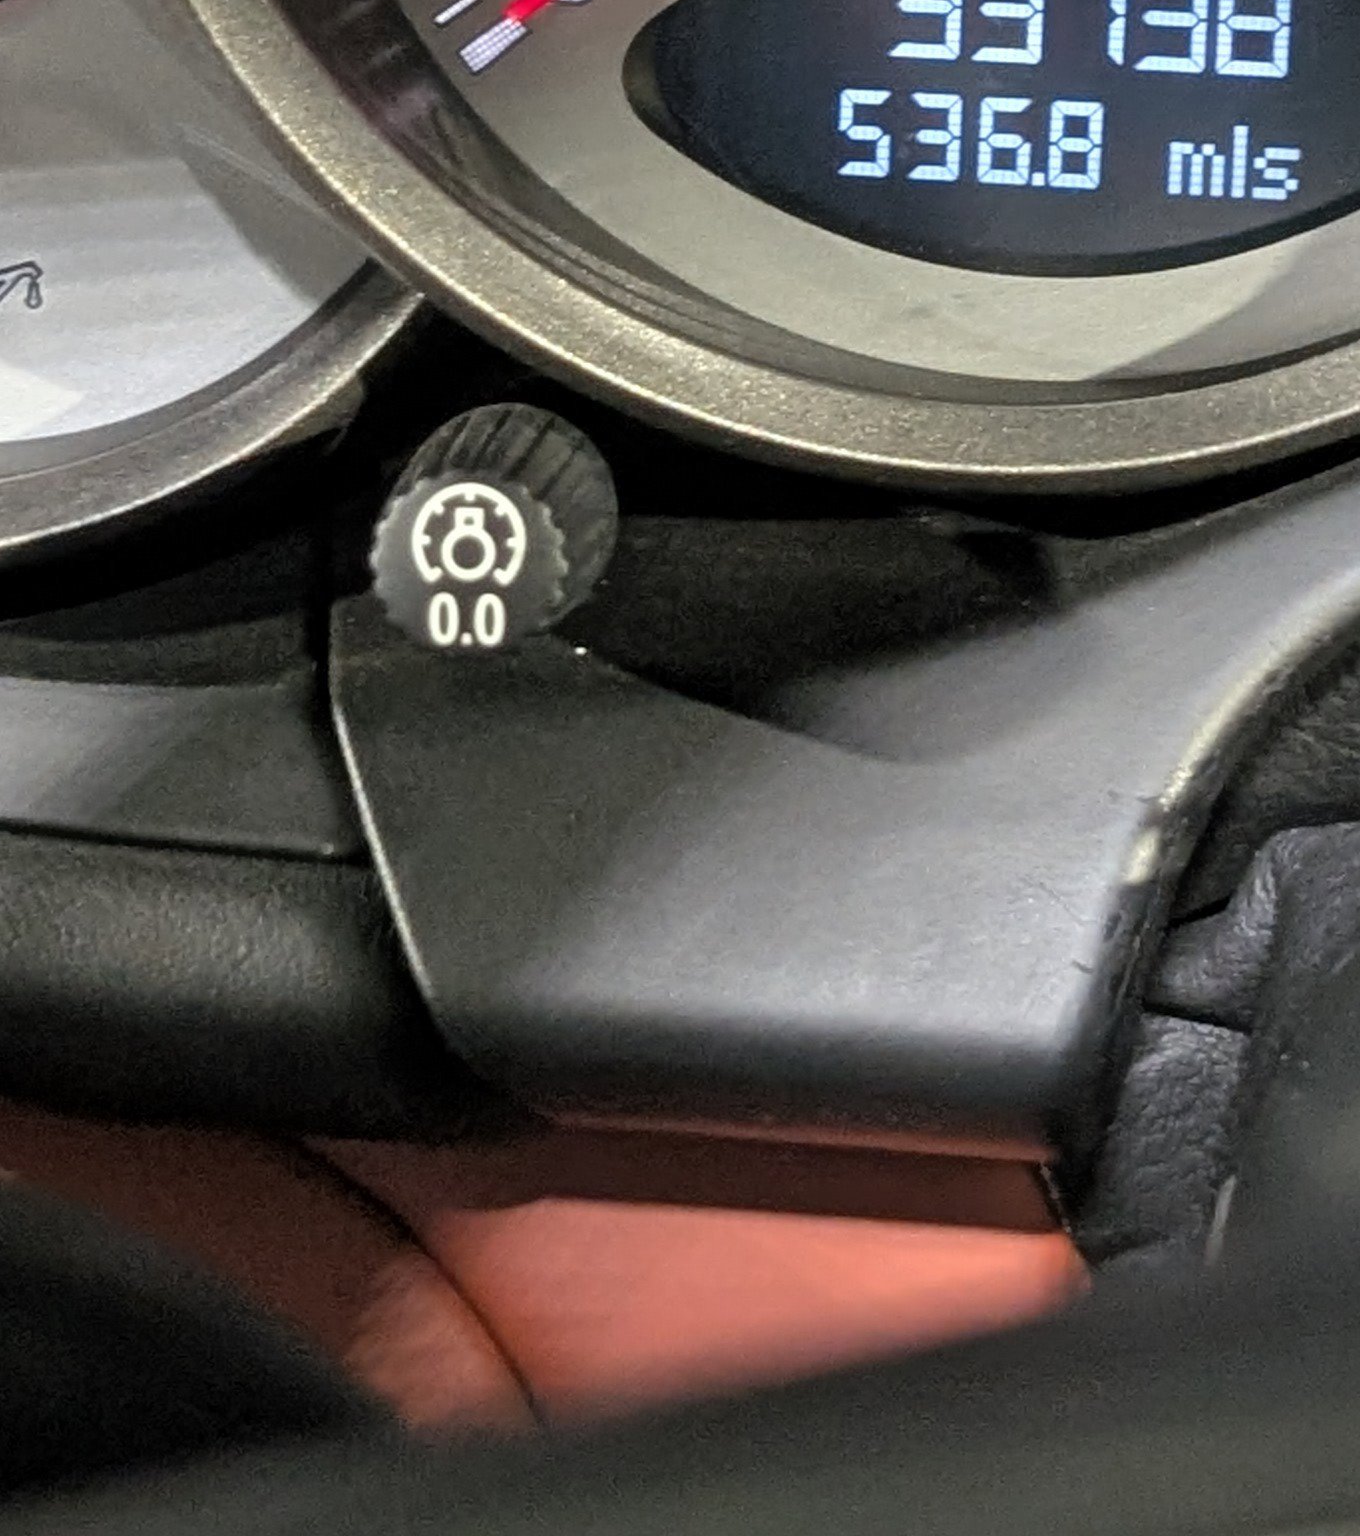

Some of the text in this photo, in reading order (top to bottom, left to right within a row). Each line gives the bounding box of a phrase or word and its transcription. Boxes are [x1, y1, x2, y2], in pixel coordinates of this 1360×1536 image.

[837, 88, 1303, 201] 536.8 mls
[428, 591, 506, 648] 0.0
